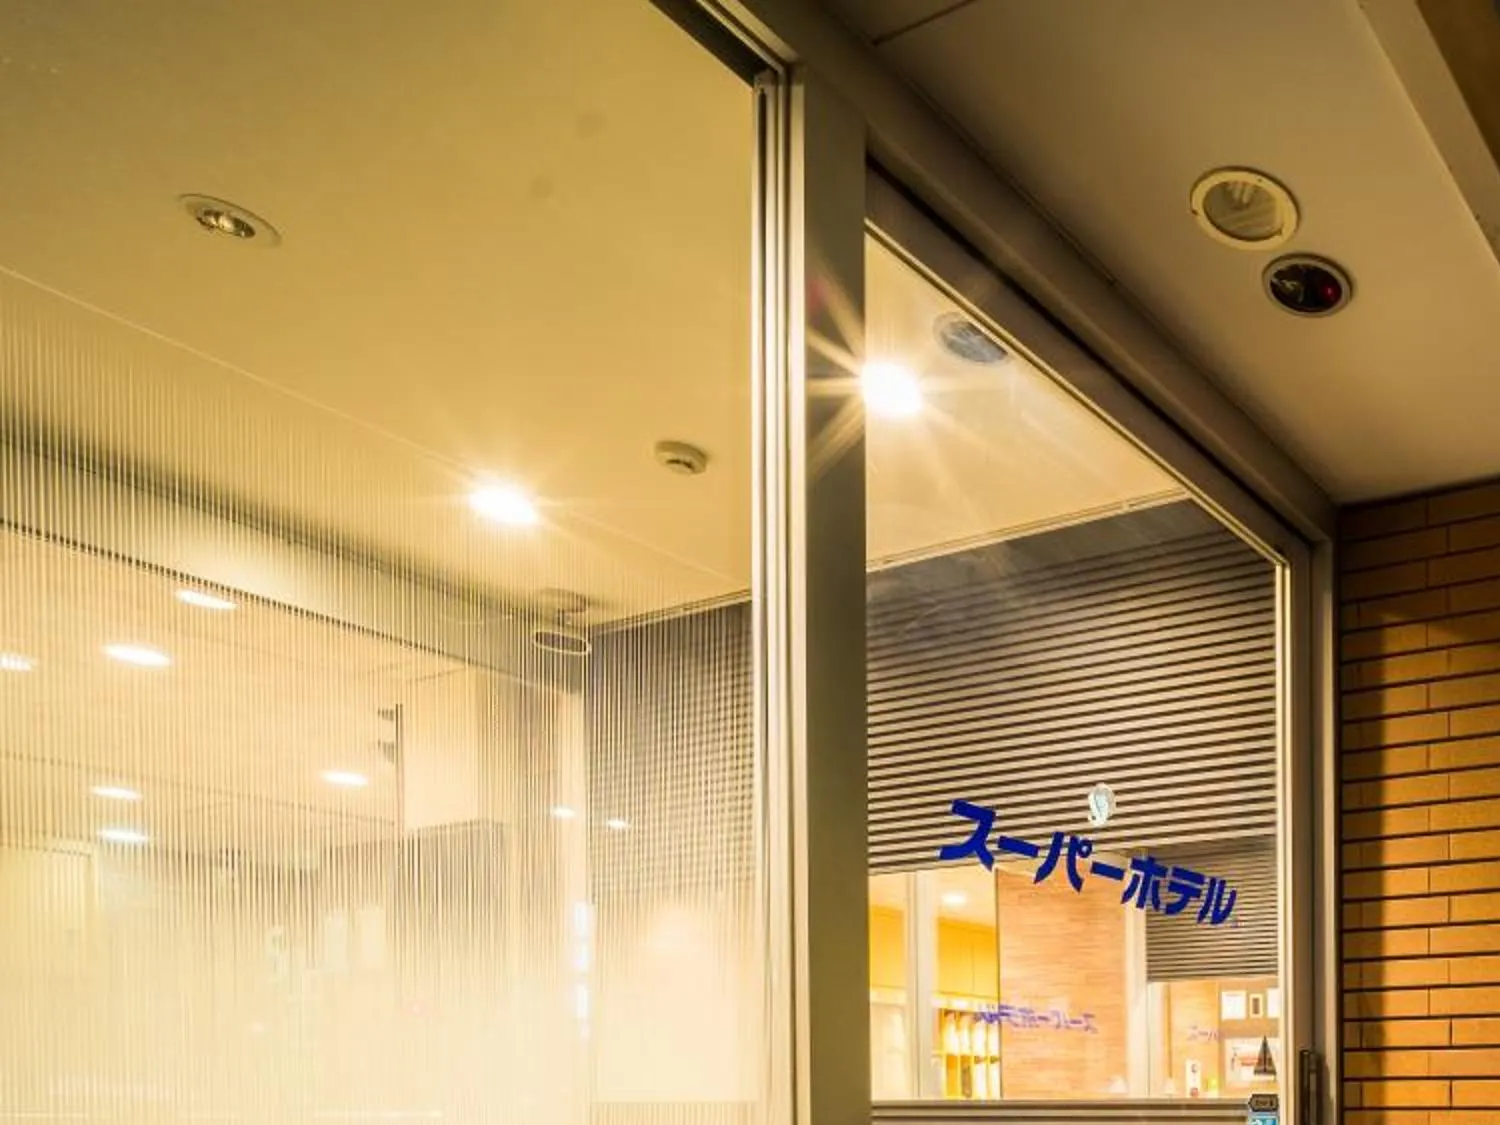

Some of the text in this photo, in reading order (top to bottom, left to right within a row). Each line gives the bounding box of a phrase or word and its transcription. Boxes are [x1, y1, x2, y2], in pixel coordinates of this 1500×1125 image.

[938, 798, 1237, 926] スーパーホテル
